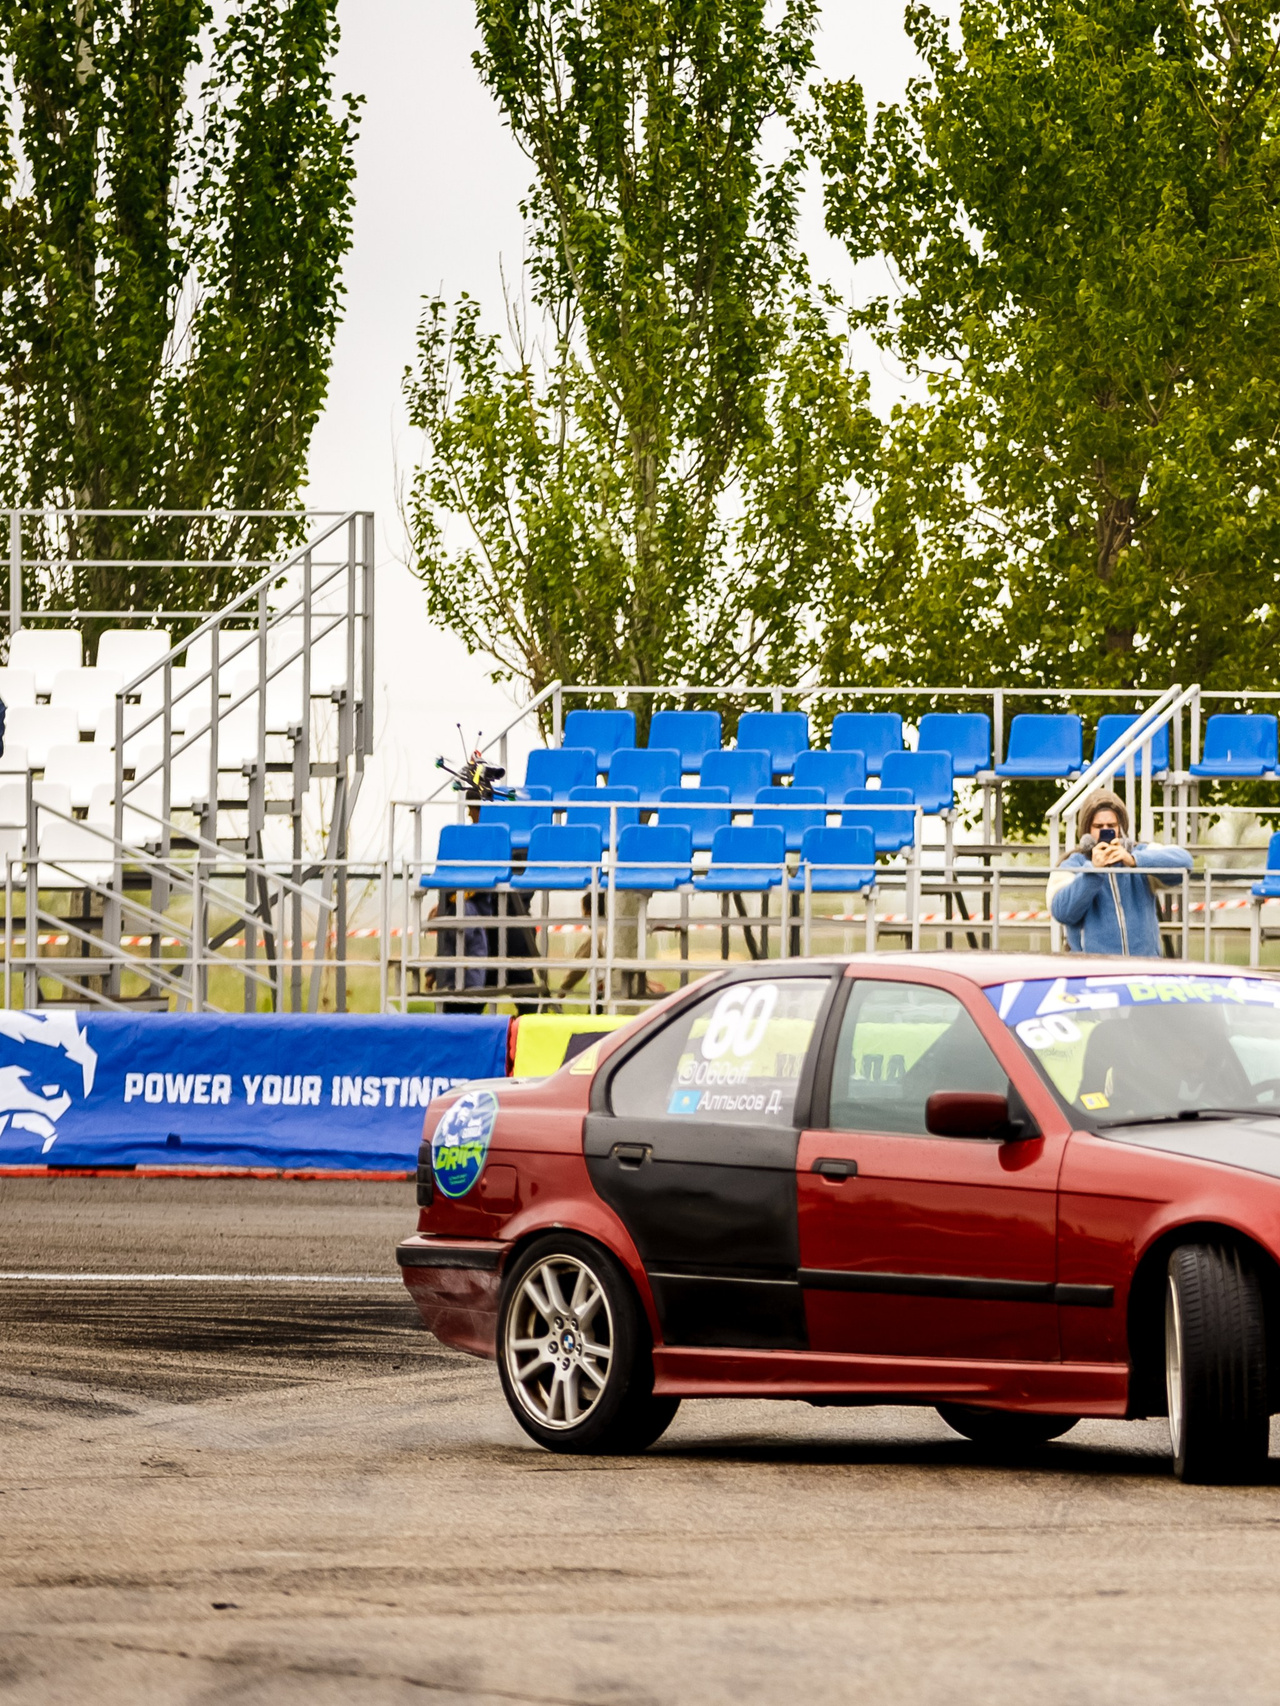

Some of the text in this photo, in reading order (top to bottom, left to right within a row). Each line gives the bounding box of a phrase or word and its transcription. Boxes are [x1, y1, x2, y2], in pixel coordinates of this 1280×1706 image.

[701, 984, 779, 1060] 60
[1015, 1014, 1082, 1050] 60
[124, 1072, 232, 1105] POWER
[242, 1073, 323, 1106] YOUR
[696, 1090, 765, 1111] Алпысов
